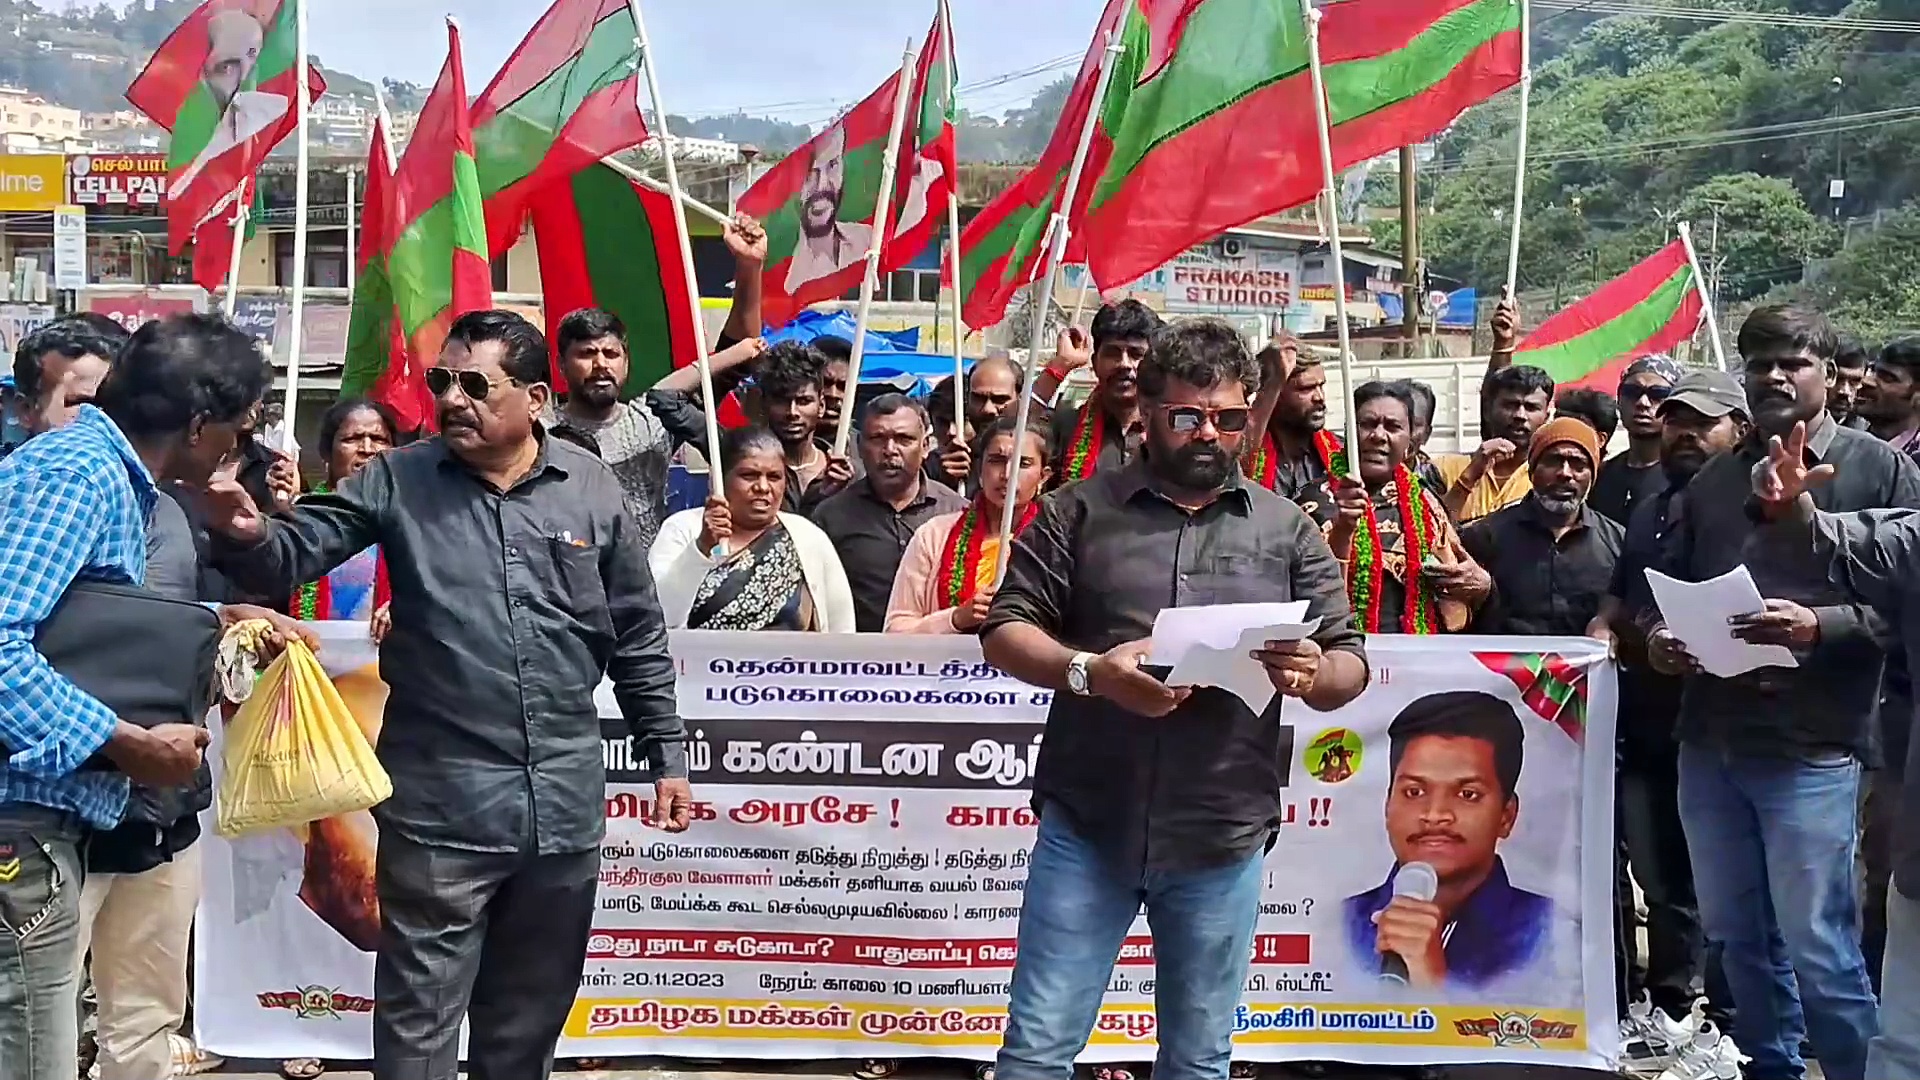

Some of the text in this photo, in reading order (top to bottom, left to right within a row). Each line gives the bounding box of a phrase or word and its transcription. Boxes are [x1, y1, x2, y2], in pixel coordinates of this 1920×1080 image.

[73, 176, 123, 193] CELL
[1174, 266, 1290, 288] PRAKASH
[1186, 286, 1290, 306] STUDIOS
[706, 684, 1018, 706] படுகொலைகளை
[722, 730, 944, 776] கண்டன
[729, 795, 878, 827] அரசே
[640, 843, 790, 862] படுகொலைகளை
[795, 846, 858, 868] தடுத்து
[862, 846, 930, 871] நிறுத்து
[944, 847, 1007, 871] தடுத்து
[688, 868, 773, 886] வேளாளர்
[779, 869, 841, 890] மக்கள்
[846, 875, 924, 893] தனியாக
[929, 874, 977, 893] வயல்
[651, 893, 722, 912] மேய்க்க
[727, 901, 763, 913] கூட
[768, 896, 948, 921] செல்லமுடியவில்லை
[587, 935, 640, 957] இது
[646, 938, 706, 957] நாடா
[714, 936, 835, 958] சுடுகாடா?
[855, 941, 973, 967] பாதுகாப்பு
[623, 972, 725, 988] 20.11.2023
[760, 971, 817, 994] நேரம்:
[823, 977, 887, 993] காலை
[894, 981, 912, 995] 10
[590, 1002, 719, 1032] தமிழக
[728, 1005, 853, 1028] மக்கள்
[859, 1009, 1009, 1035] முன்னே
[1232, 1007, 1314, 1032] நீலகிரி
[1321, 1010, 1435, 1030] மாவட்டம்
